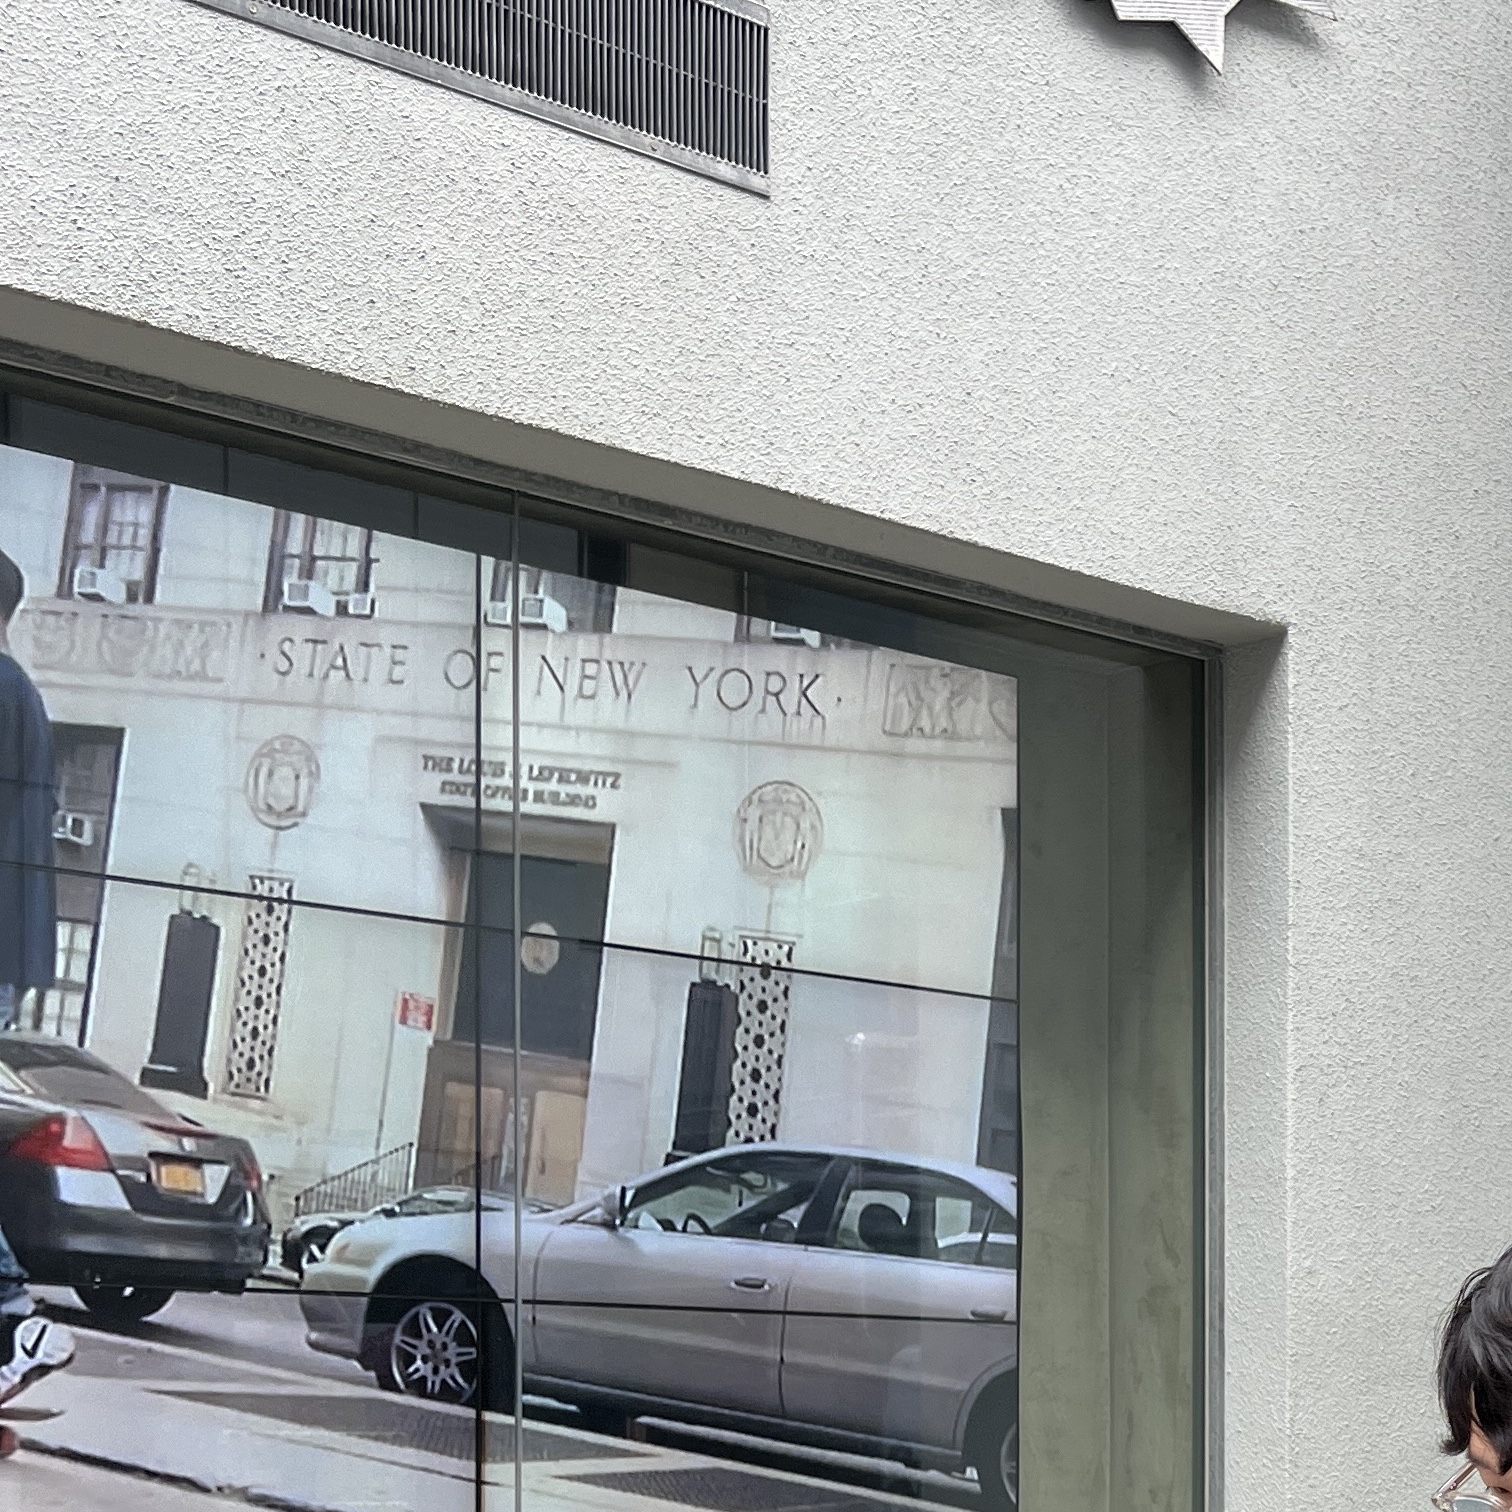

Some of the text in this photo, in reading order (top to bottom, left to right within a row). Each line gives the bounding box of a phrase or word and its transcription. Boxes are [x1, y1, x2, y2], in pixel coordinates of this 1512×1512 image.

[273, 636, 824, 717] STATE OF NEW YORK
